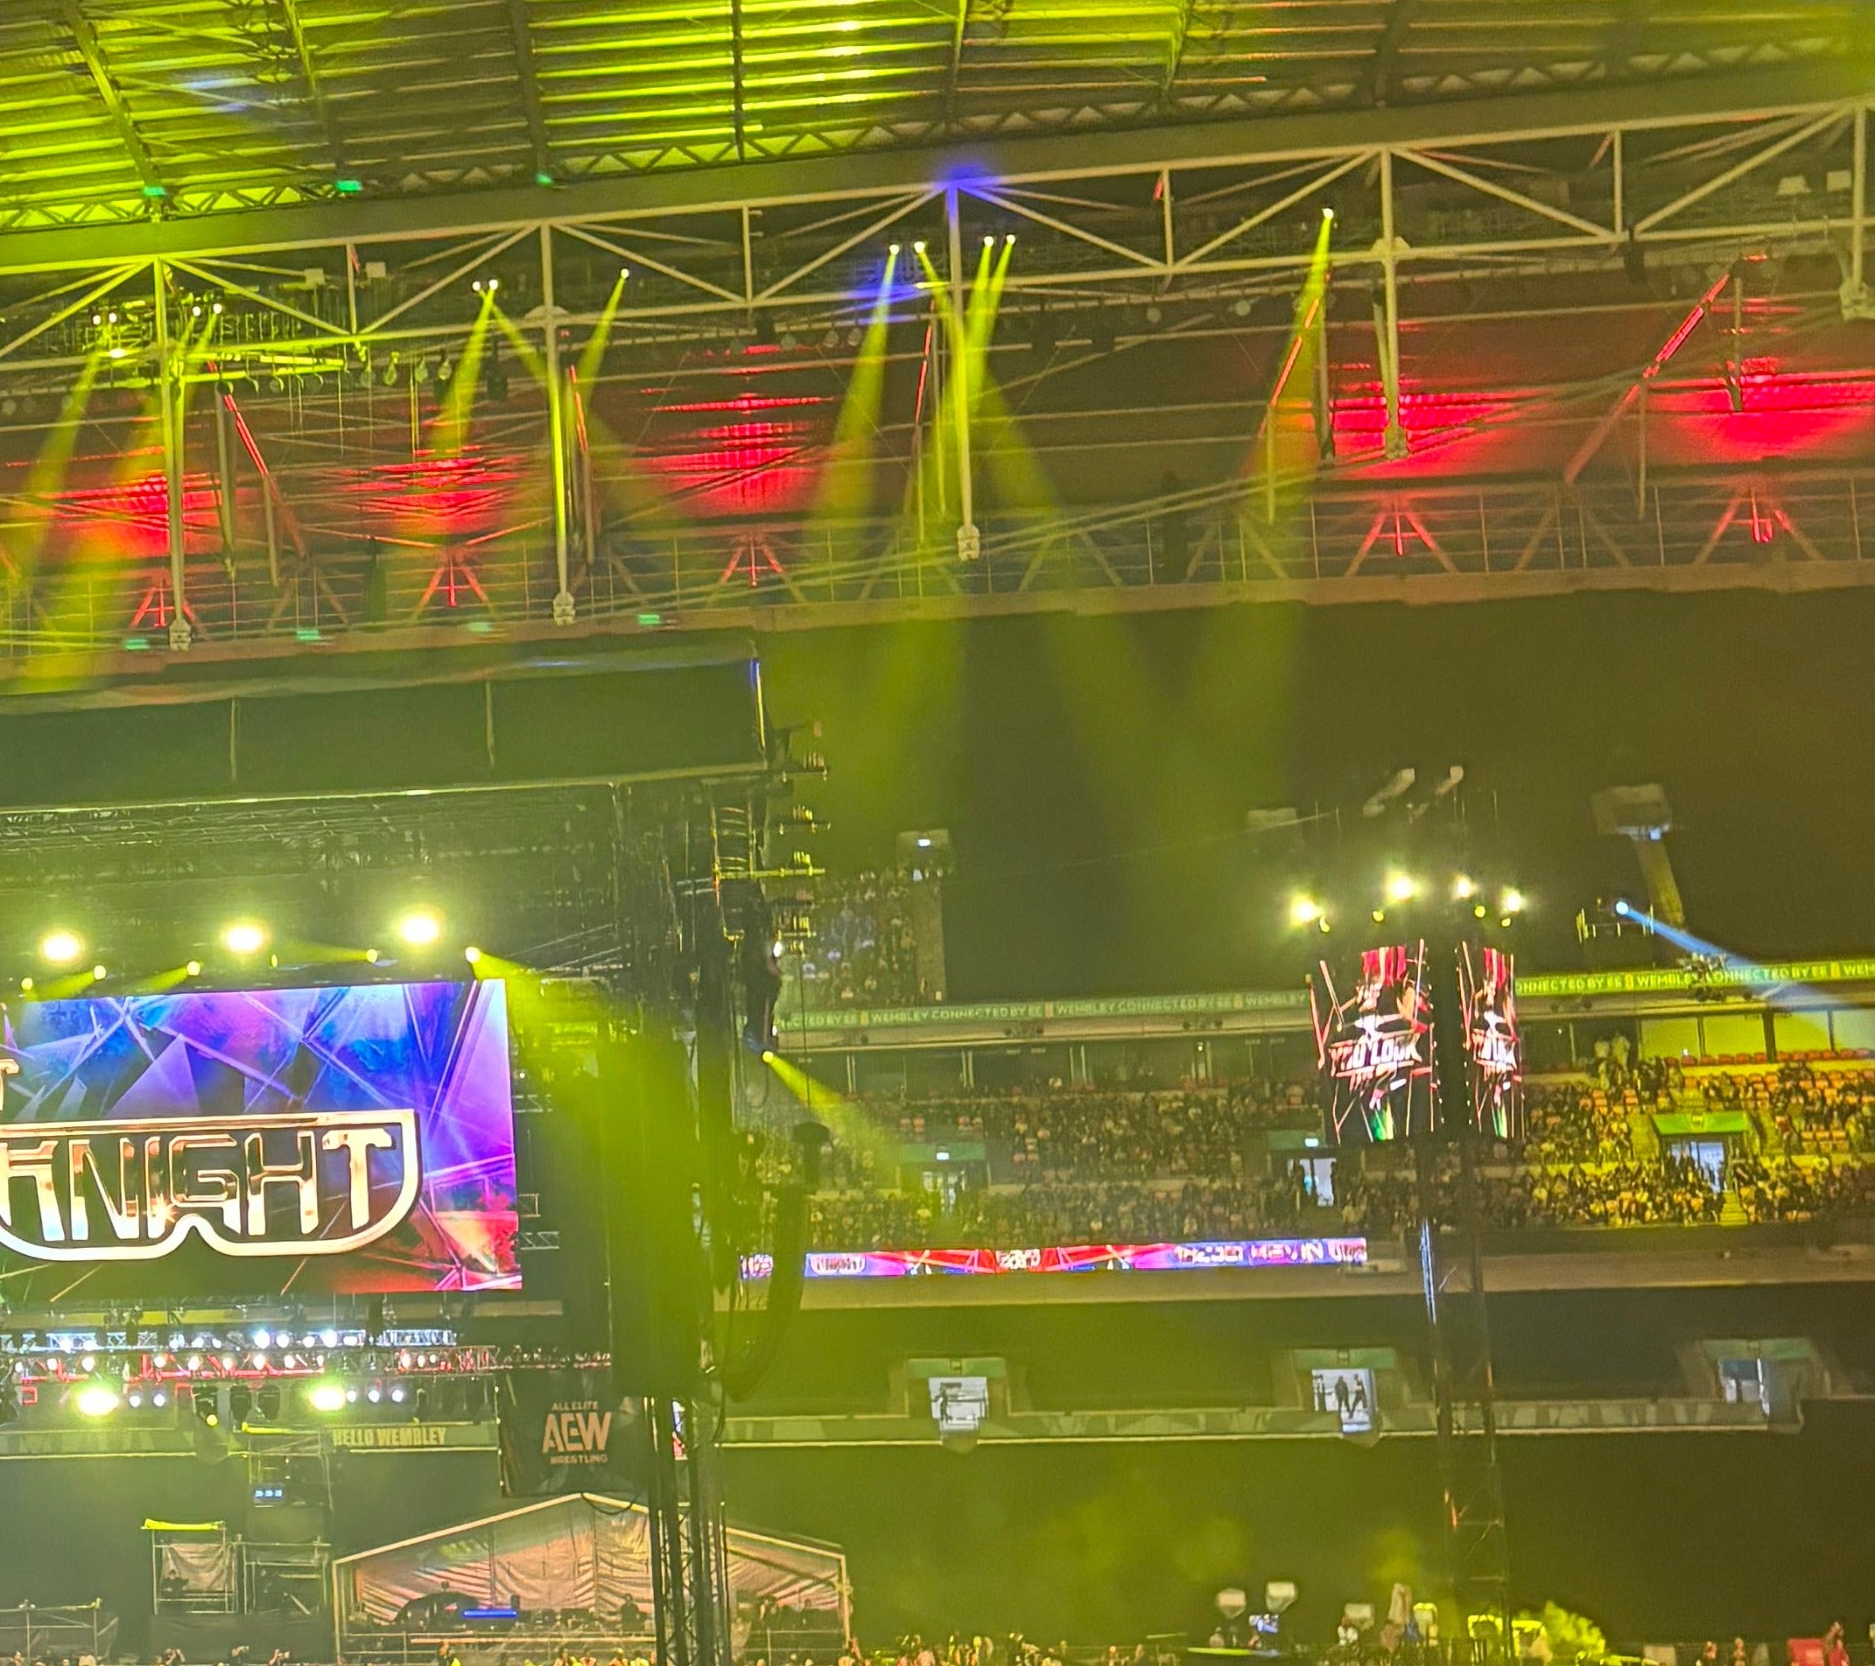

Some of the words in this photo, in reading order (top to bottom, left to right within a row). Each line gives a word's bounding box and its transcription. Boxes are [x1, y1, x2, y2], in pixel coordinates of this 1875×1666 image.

[1516, 978, 1585, 993] ONNECTED
[1637, 971, 1698, 986] WEMBLEY
[931, 1006, 1008, 1020] CONNECTED
[1010, 1005, 1025, 1017] BY
[1057, 1002, 1115, 1015] WEMBLEY
[1118, 997, 1196, 1012] CONNECTED
[1246, 993, 1306, 1006] WEMBLEY
[332, 1429, 374, 1446] HELLO
[376, 1427, 446, 1445] WEMBLEY
[542, 1411, 612, 1453] AEW
